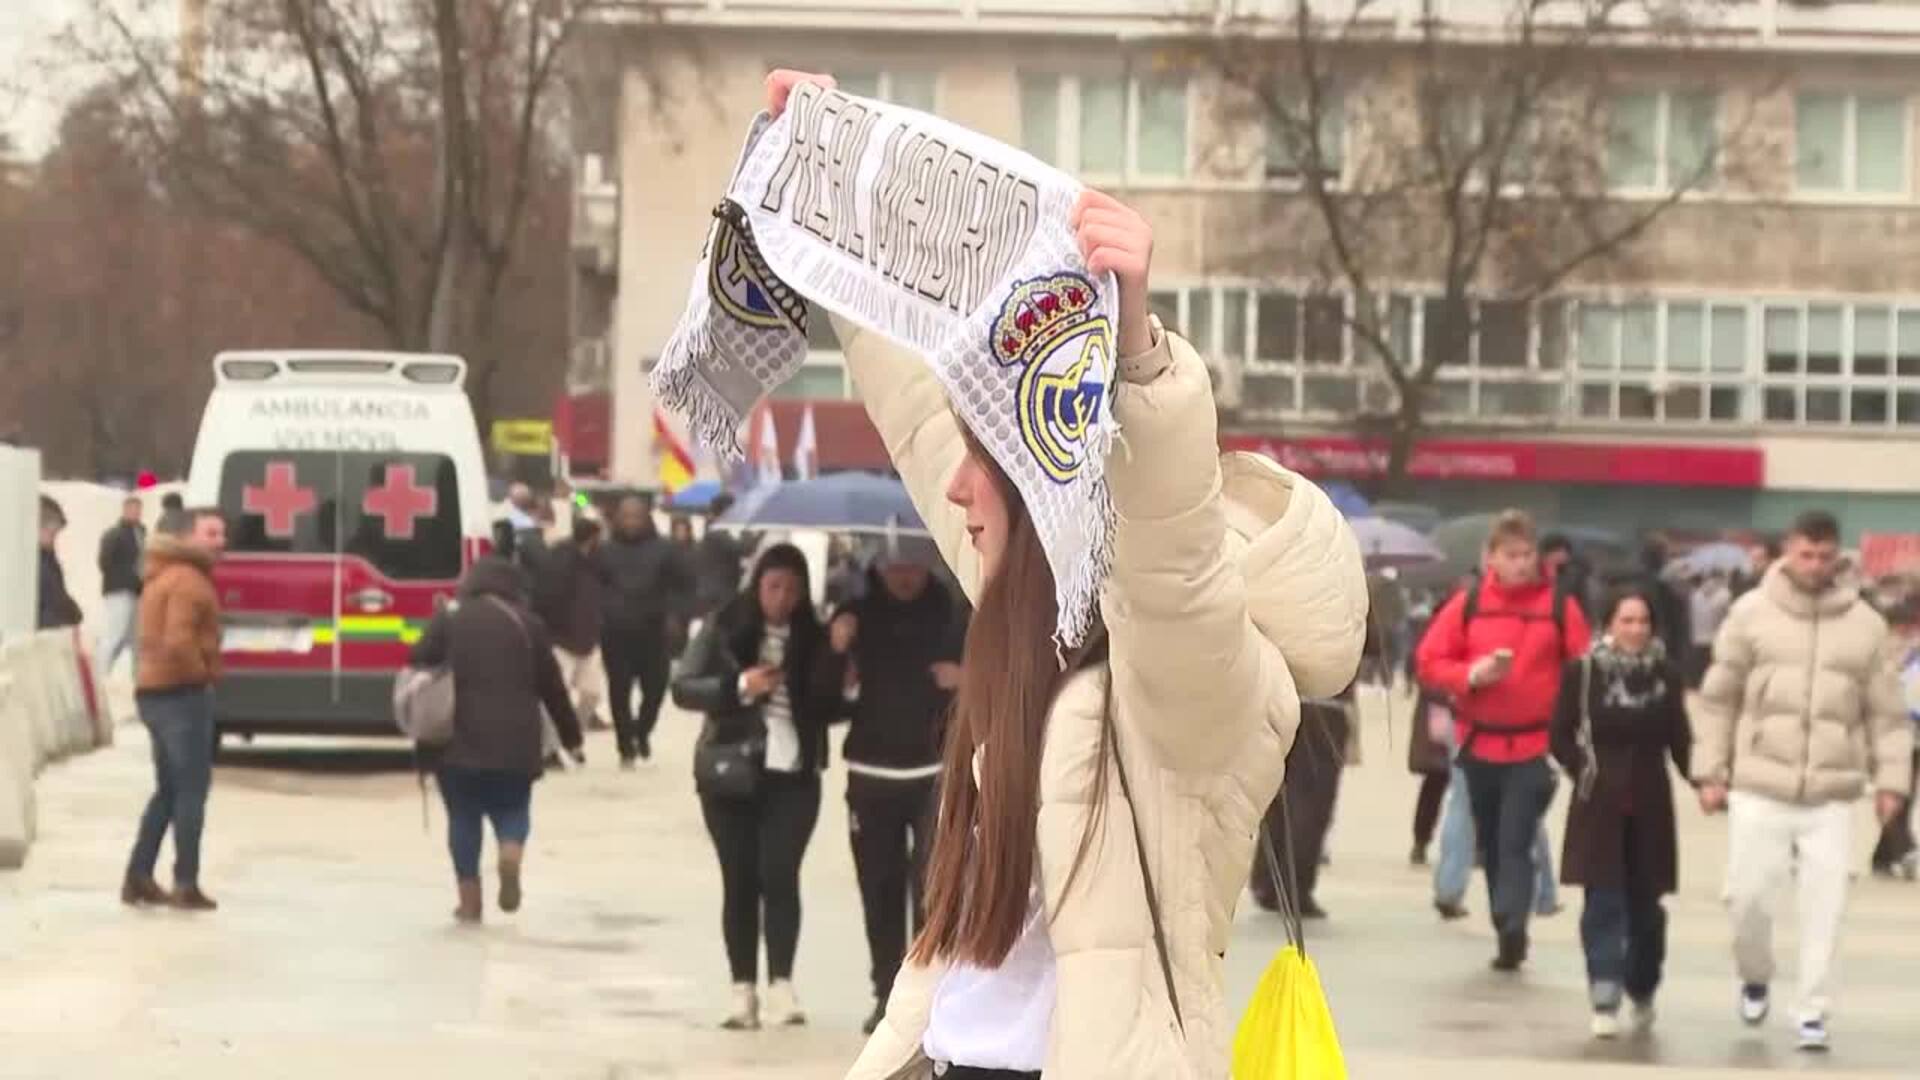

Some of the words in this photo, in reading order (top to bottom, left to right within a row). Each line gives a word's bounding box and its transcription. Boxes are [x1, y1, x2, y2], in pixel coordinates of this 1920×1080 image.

[760, 81, 883, 259] REAL
[870, 123, 1038, 317] MADRID
[803, 255, 880, 324] MADRID
[250, 397, 431, 420] AMBULANCIA
